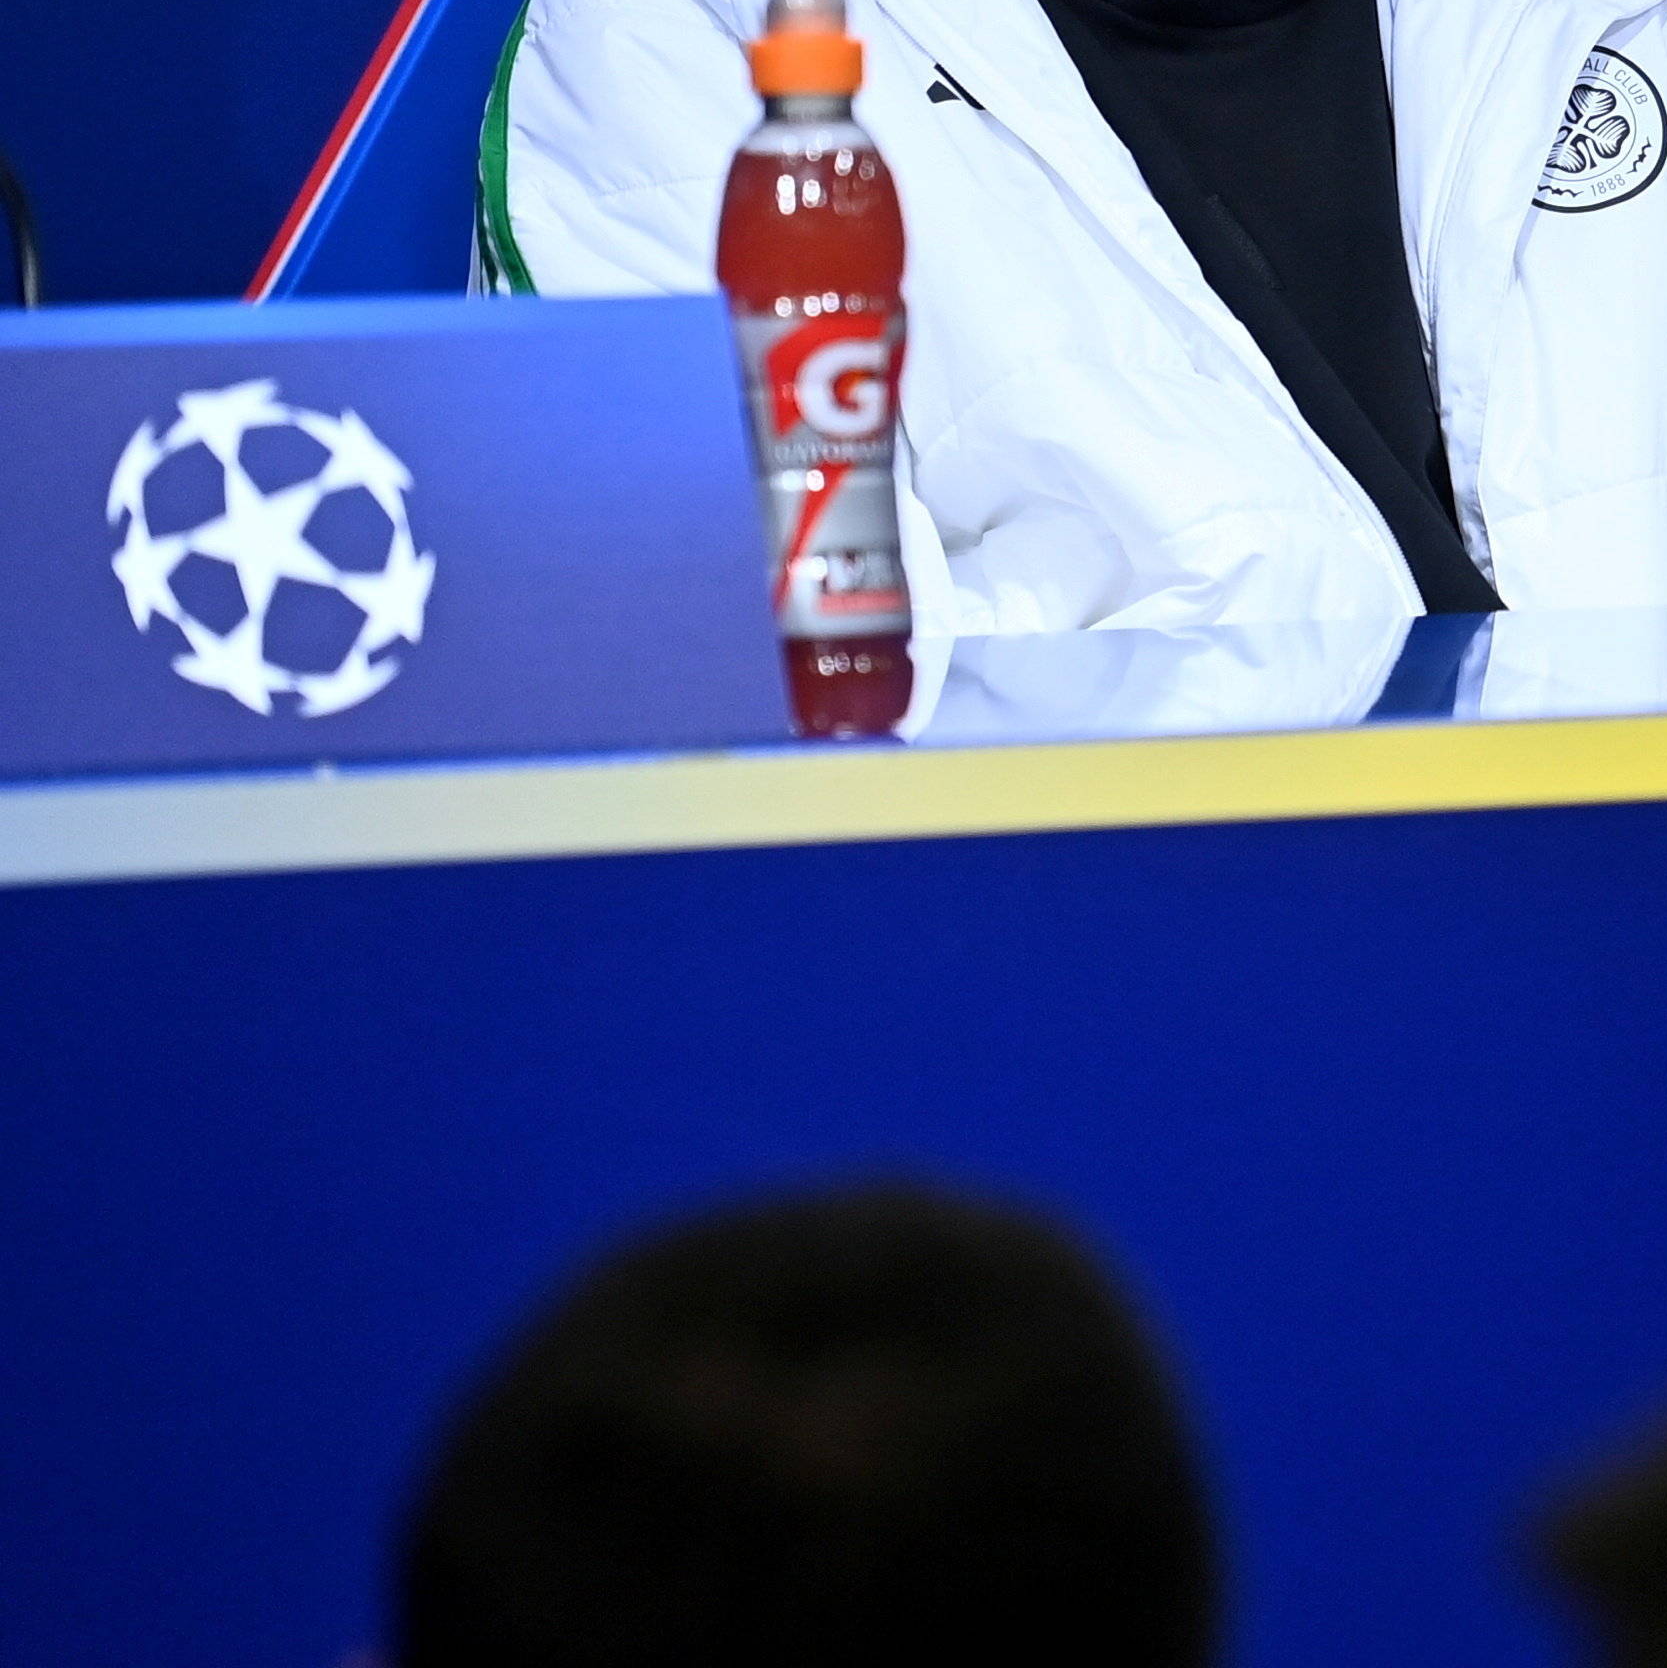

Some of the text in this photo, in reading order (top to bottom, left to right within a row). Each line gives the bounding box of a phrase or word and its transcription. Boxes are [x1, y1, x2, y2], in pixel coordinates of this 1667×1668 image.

[1614, 69, 1648, 106] CLUB
[1590, 174, 1625, 197] 1888
[794, 340, 887, 438] G
